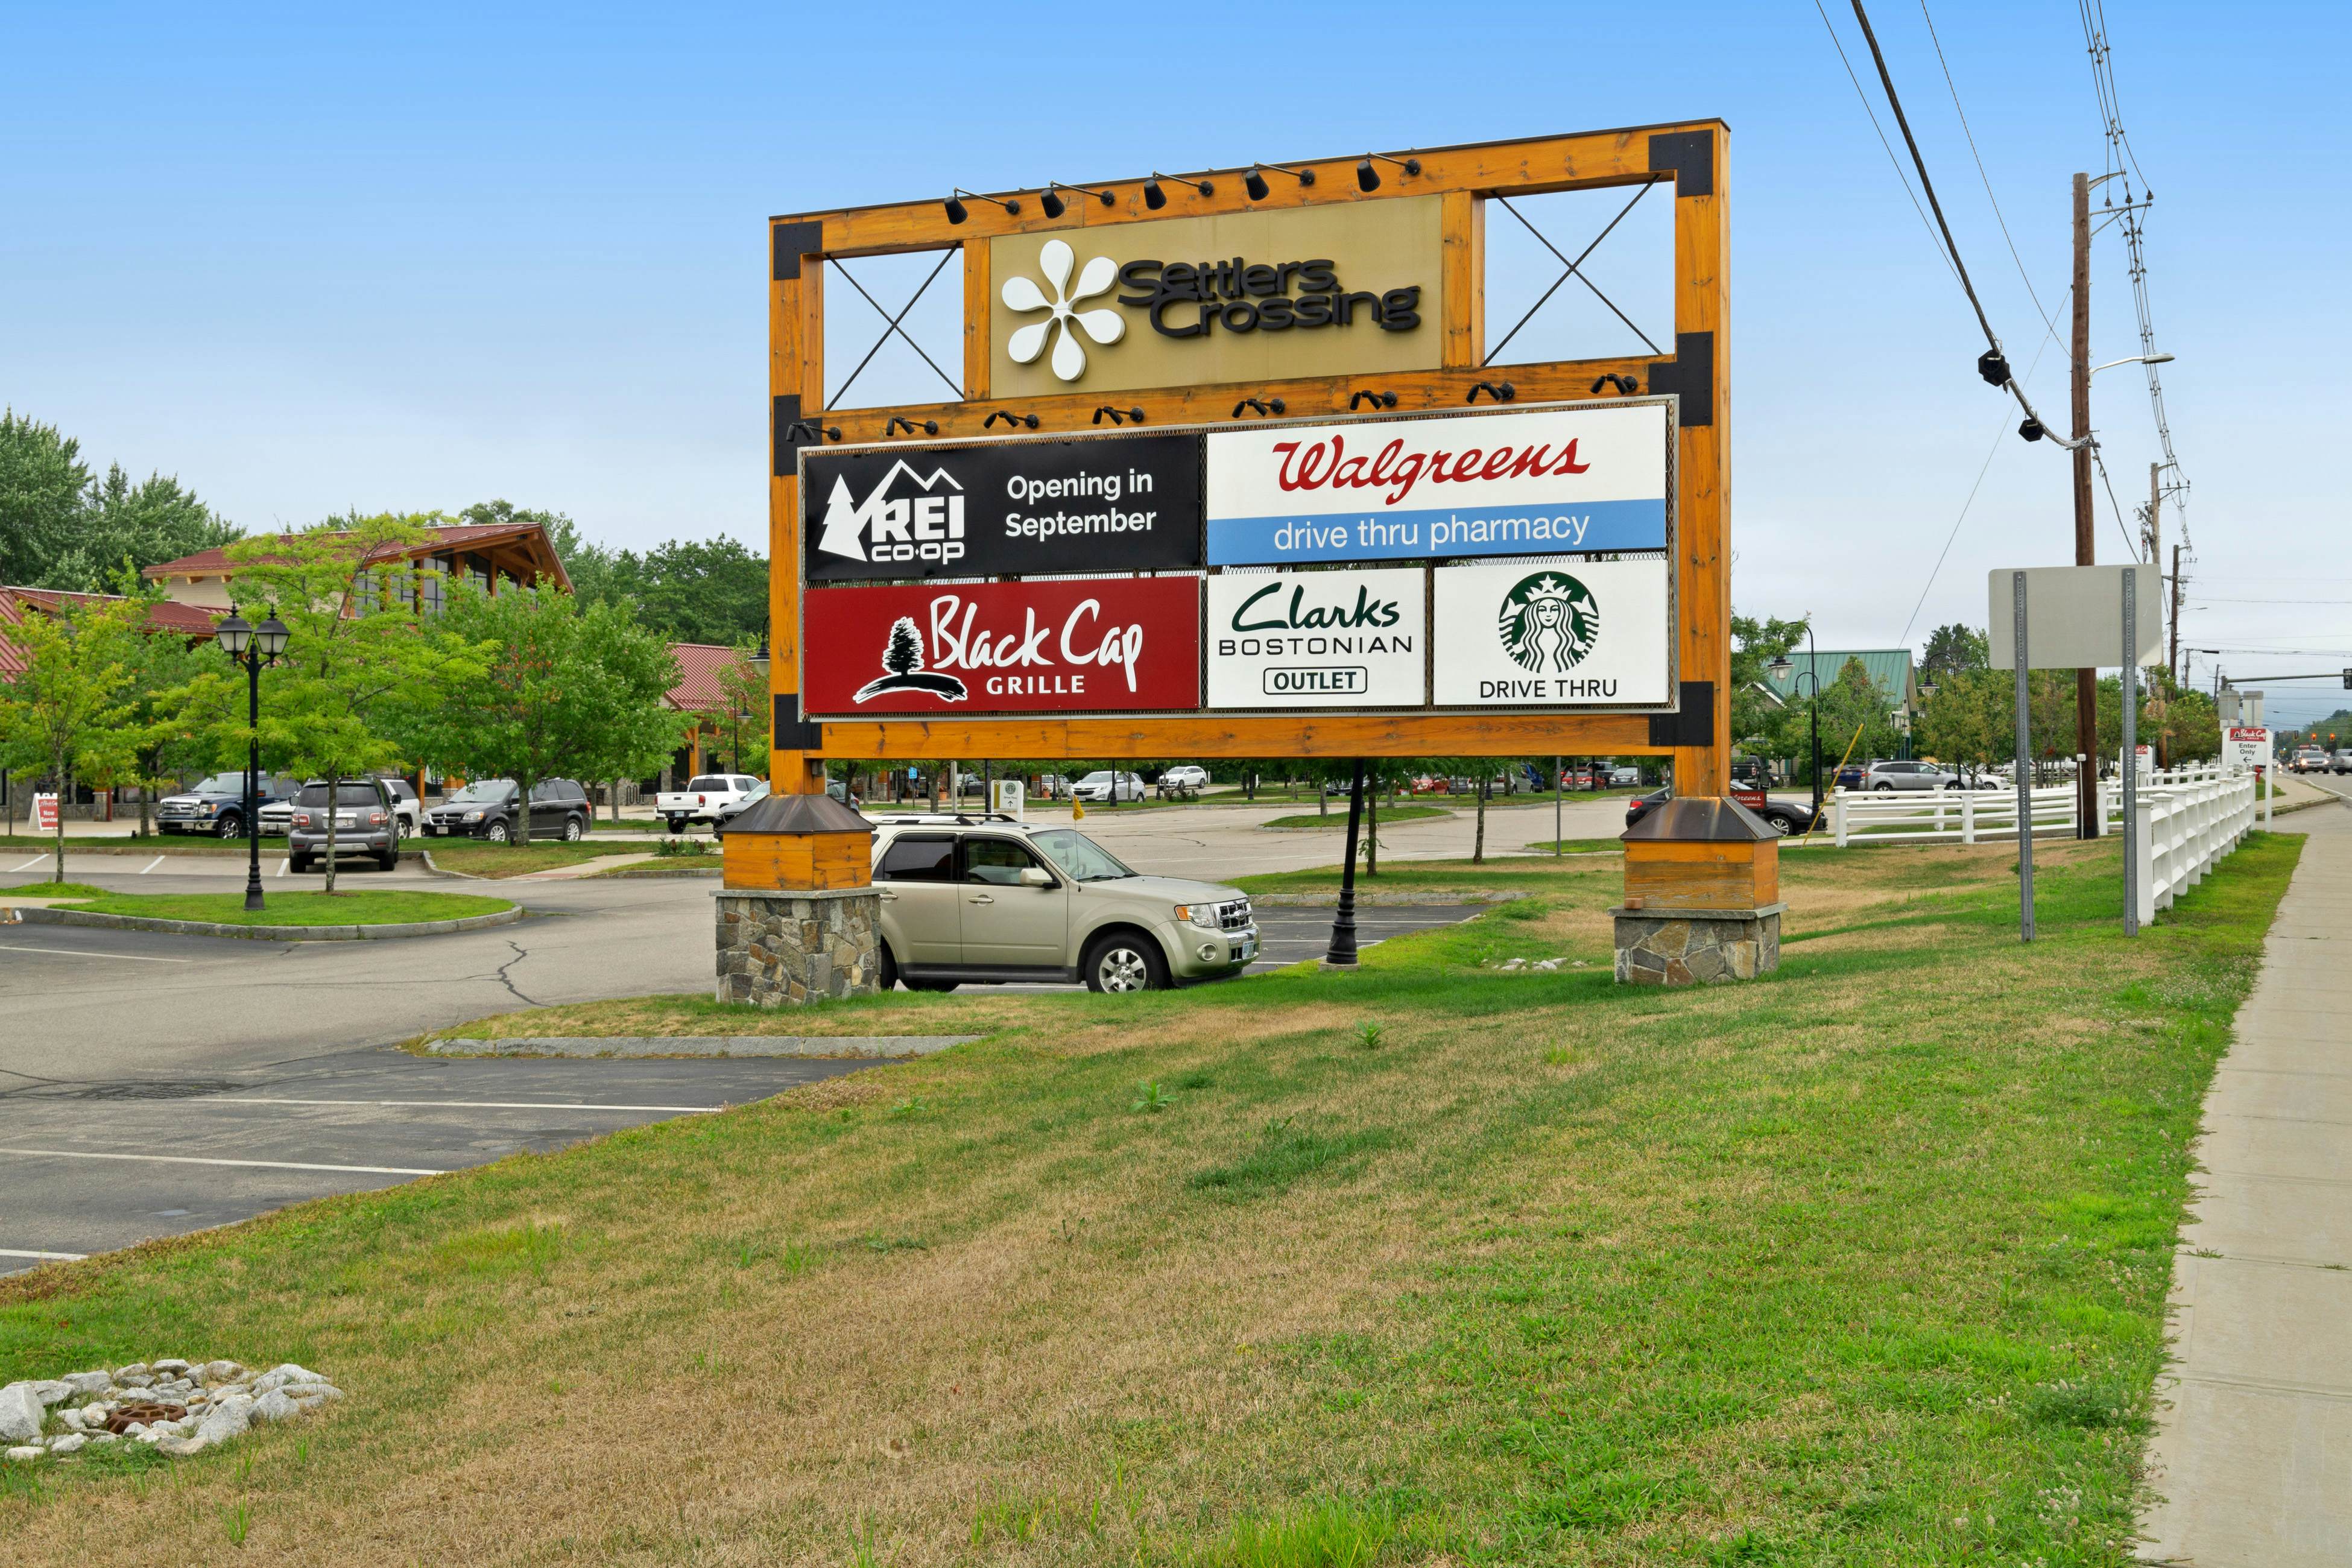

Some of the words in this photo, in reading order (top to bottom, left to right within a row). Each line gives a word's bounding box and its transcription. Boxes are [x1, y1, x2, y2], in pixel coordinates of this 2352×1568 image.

[1118, 256, 1340, 305] Settlers
[1149, 285, 1421, 338] Crossing
[1007, 470, 1121, 504] Opening
[1129, 468, 1152, 493] in
[1272, 434, 1591, 505] Walgreens
[871, 495, 965, 541] REI
[1005, 507, 1157, 541] September
[1274, 521, 1348, 551] drive
[1357, 518, 1419, 548] thru
[1430, 515, 1590, 552] pharmacy
[1231, 581, 1400, 633] Clarks
[929, 595, 1055, 669] Black
[1060, 598, 1143, 692] Cap
[1218, 636, 1412, 656] BOSTONIAN
[986, 675, 1085, 695] GRILLE
[1274, 671, 1358, 691] OUTLET
[1480, 680, 1547, 699] DRIVE
[1554, 679, 1617, 698] THRU
